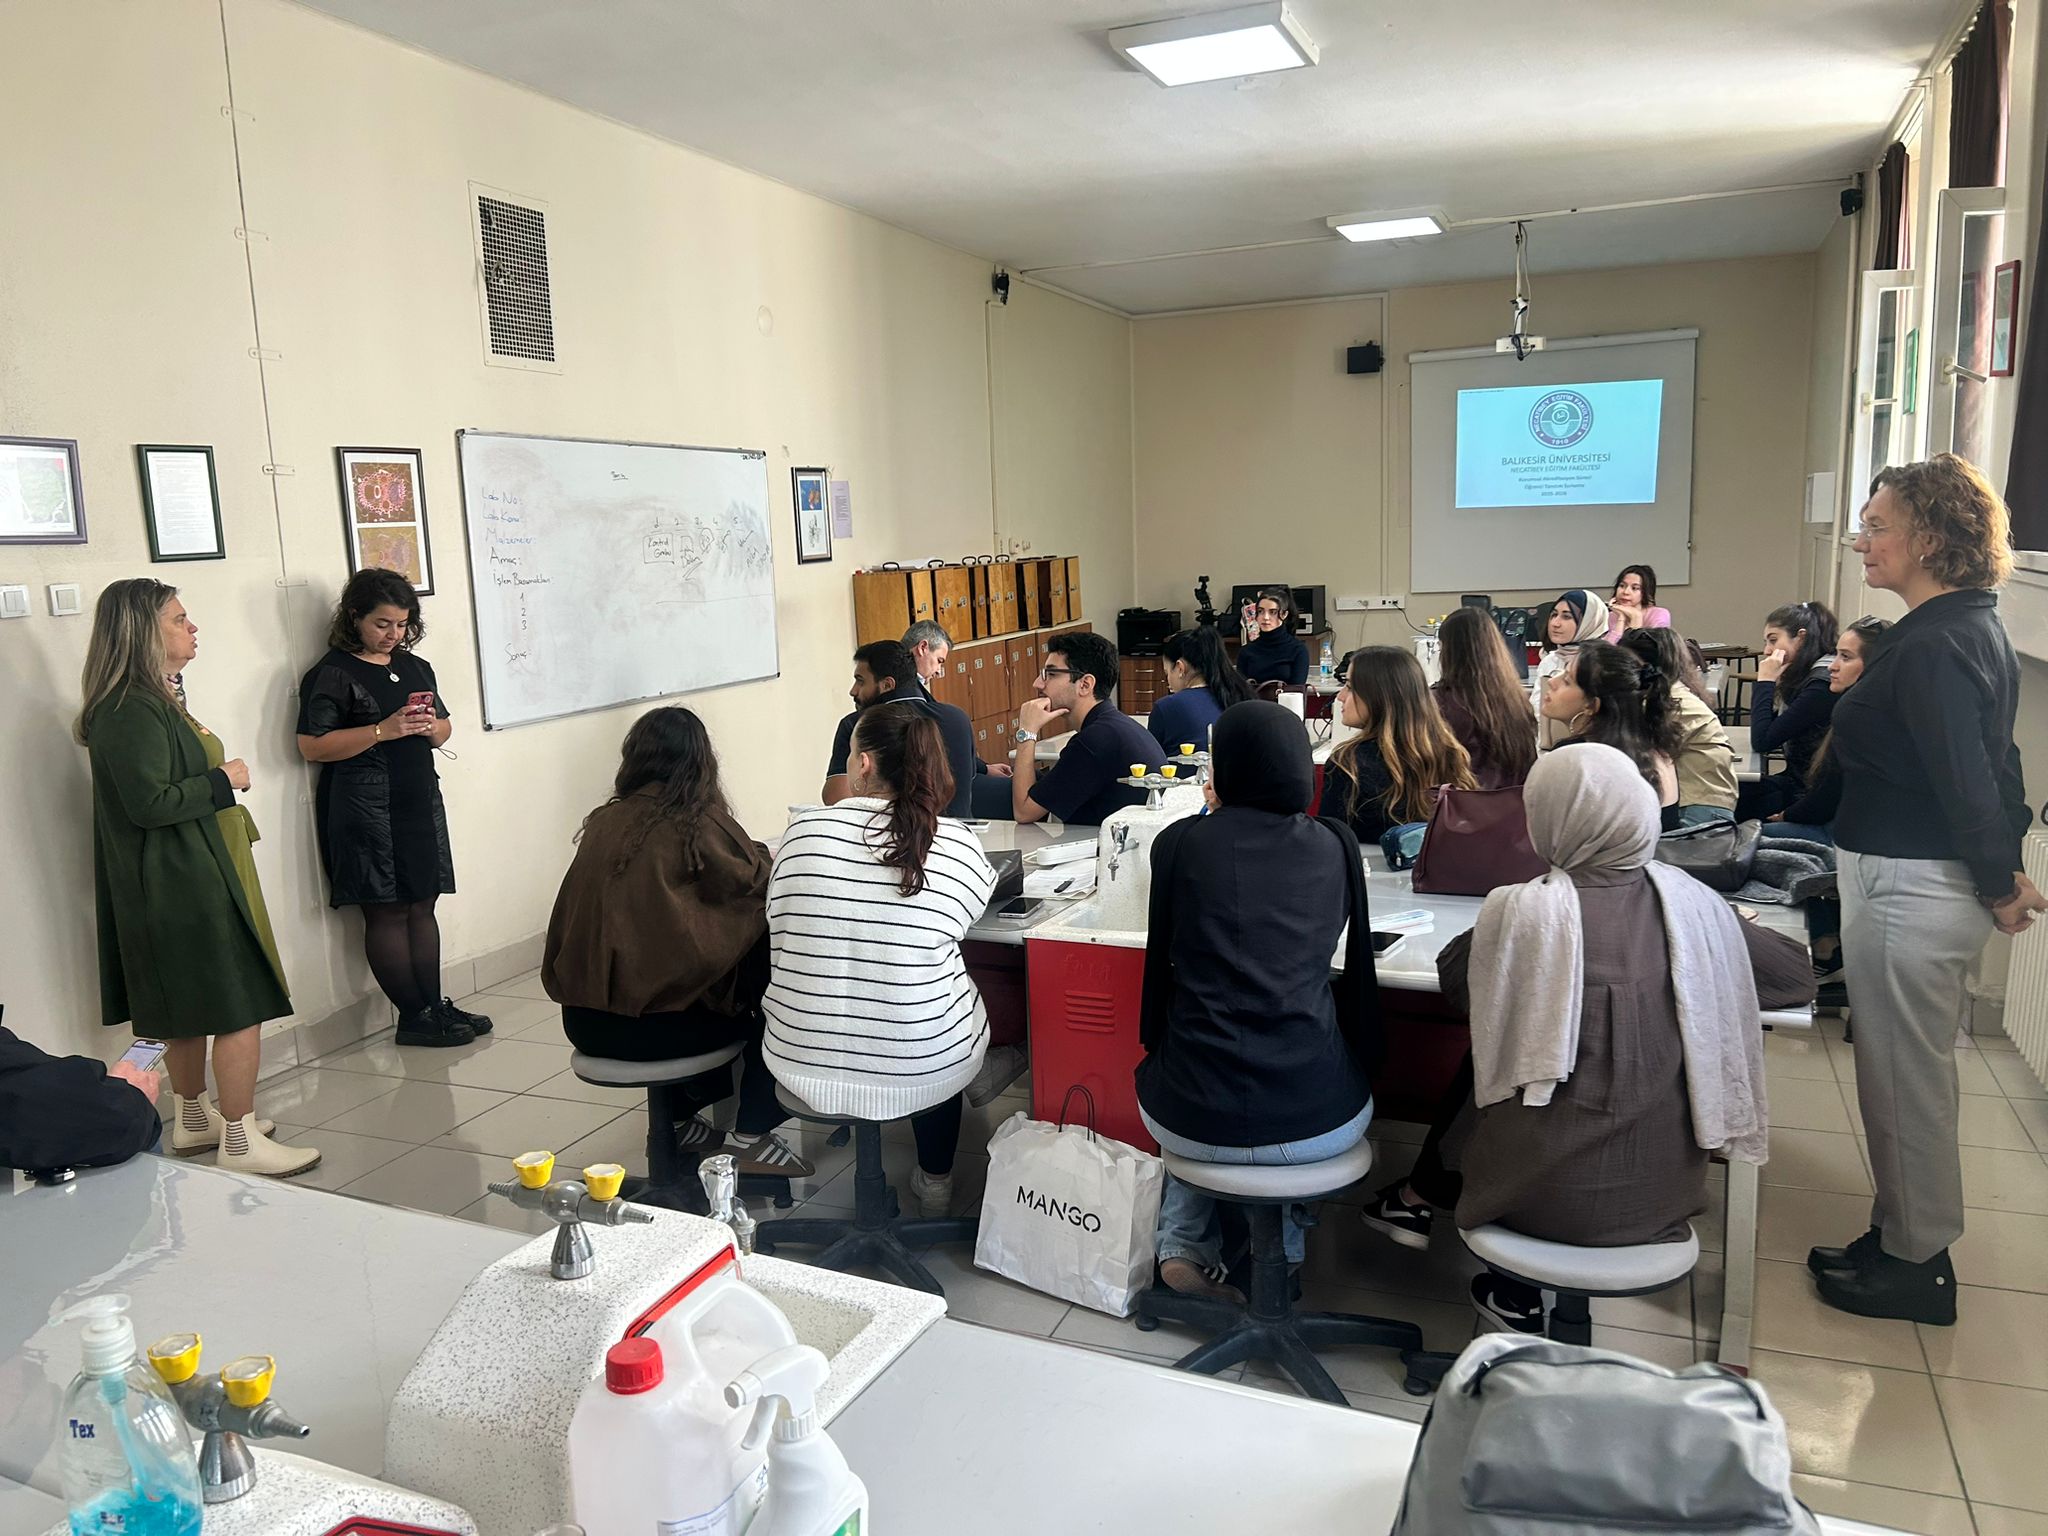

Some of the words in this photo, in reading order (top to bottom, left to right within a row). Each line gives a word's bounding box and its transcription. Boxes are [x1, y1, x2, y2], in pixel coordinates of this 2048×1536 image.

[1501, 455, 1546, 466] BALIKESİR
[1548, 452, 1611, 464] ÜNİVERSİTESİ
[1016, 1185, 1101, 1233] MANGO
[69, 1419, 96, 1439] Tex
